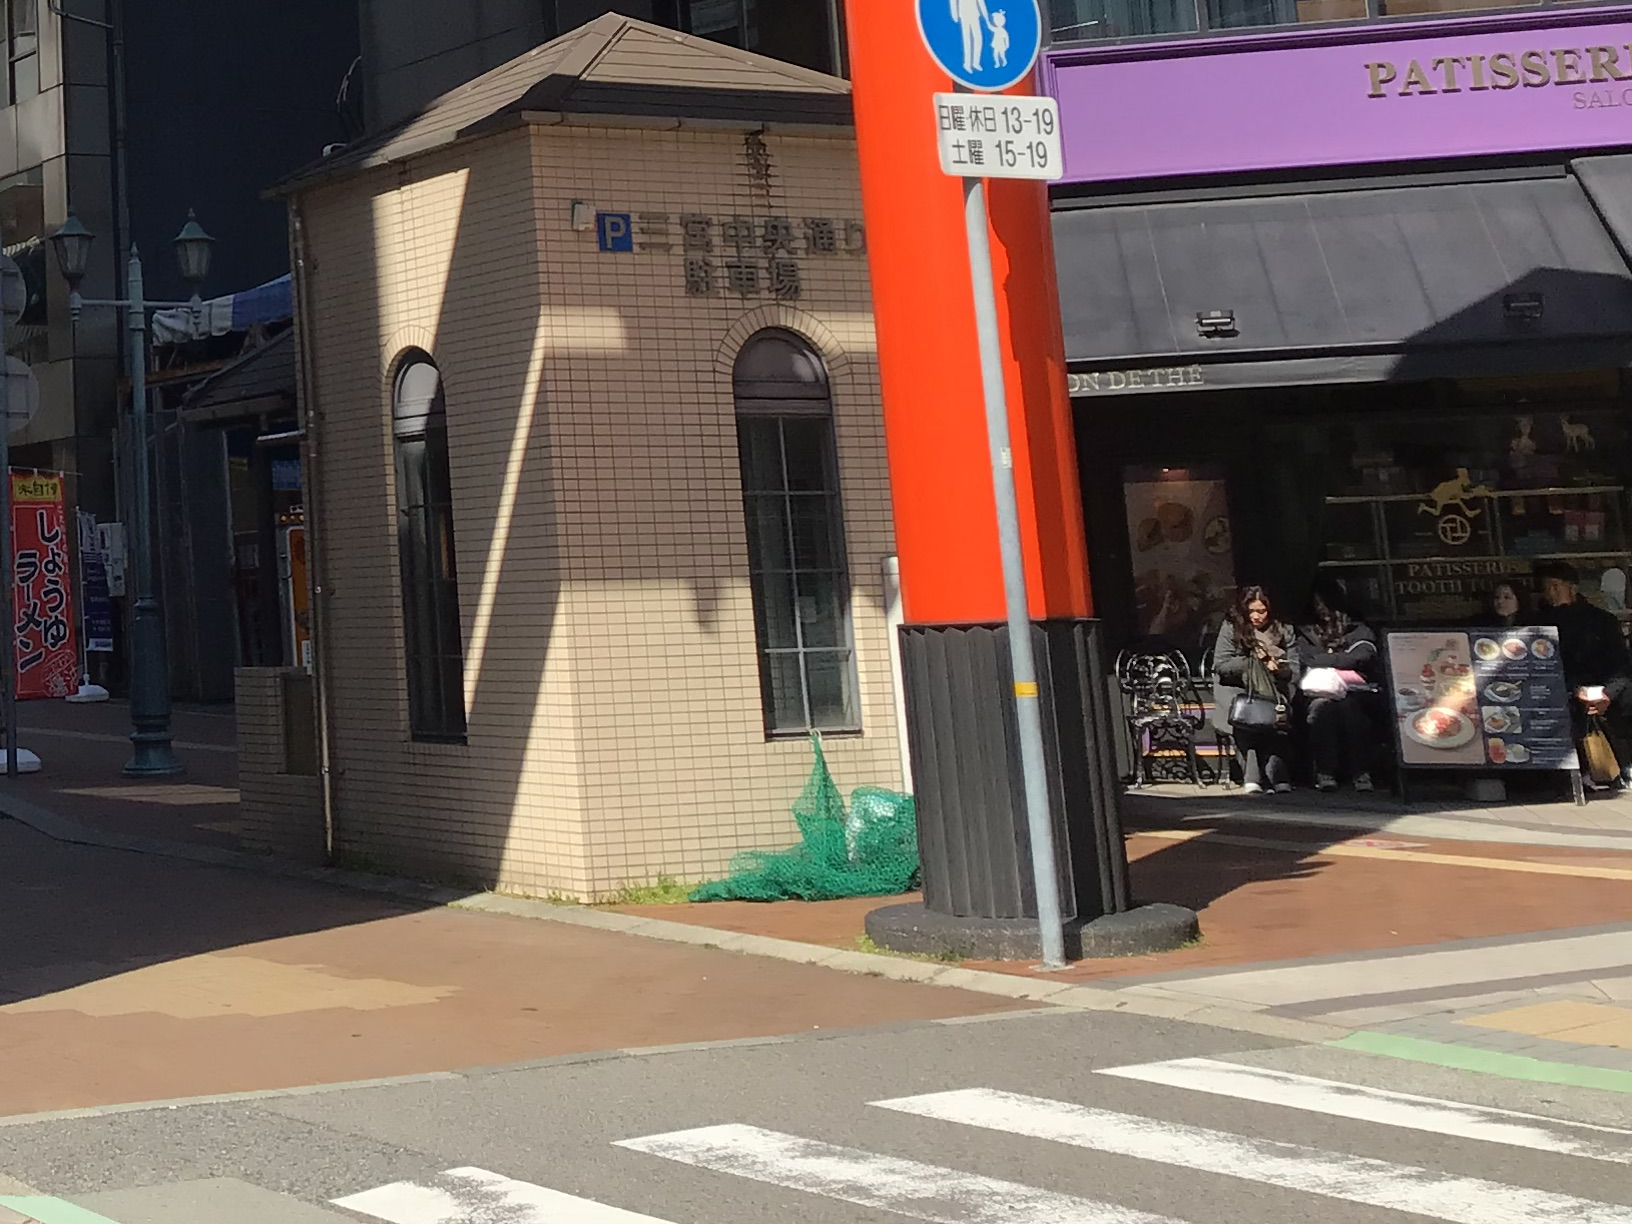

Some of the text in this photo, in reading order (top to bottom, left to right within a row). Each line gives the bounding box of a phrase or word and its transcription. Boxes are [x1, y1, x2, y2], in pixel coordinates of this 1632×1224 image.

[1001, 106, 1054, 136] 13-19
[951, 138, 1048, 169] 土曜 15-19
[604, 212, 867, 256] P 三宮中央通り
[682, 256, 802, 300] 駐車場
[1107, 369, 1145, 390] DE
[37, 510, 68, 650] しょうゆ
[15, 551, 46, 673] ラーメン
